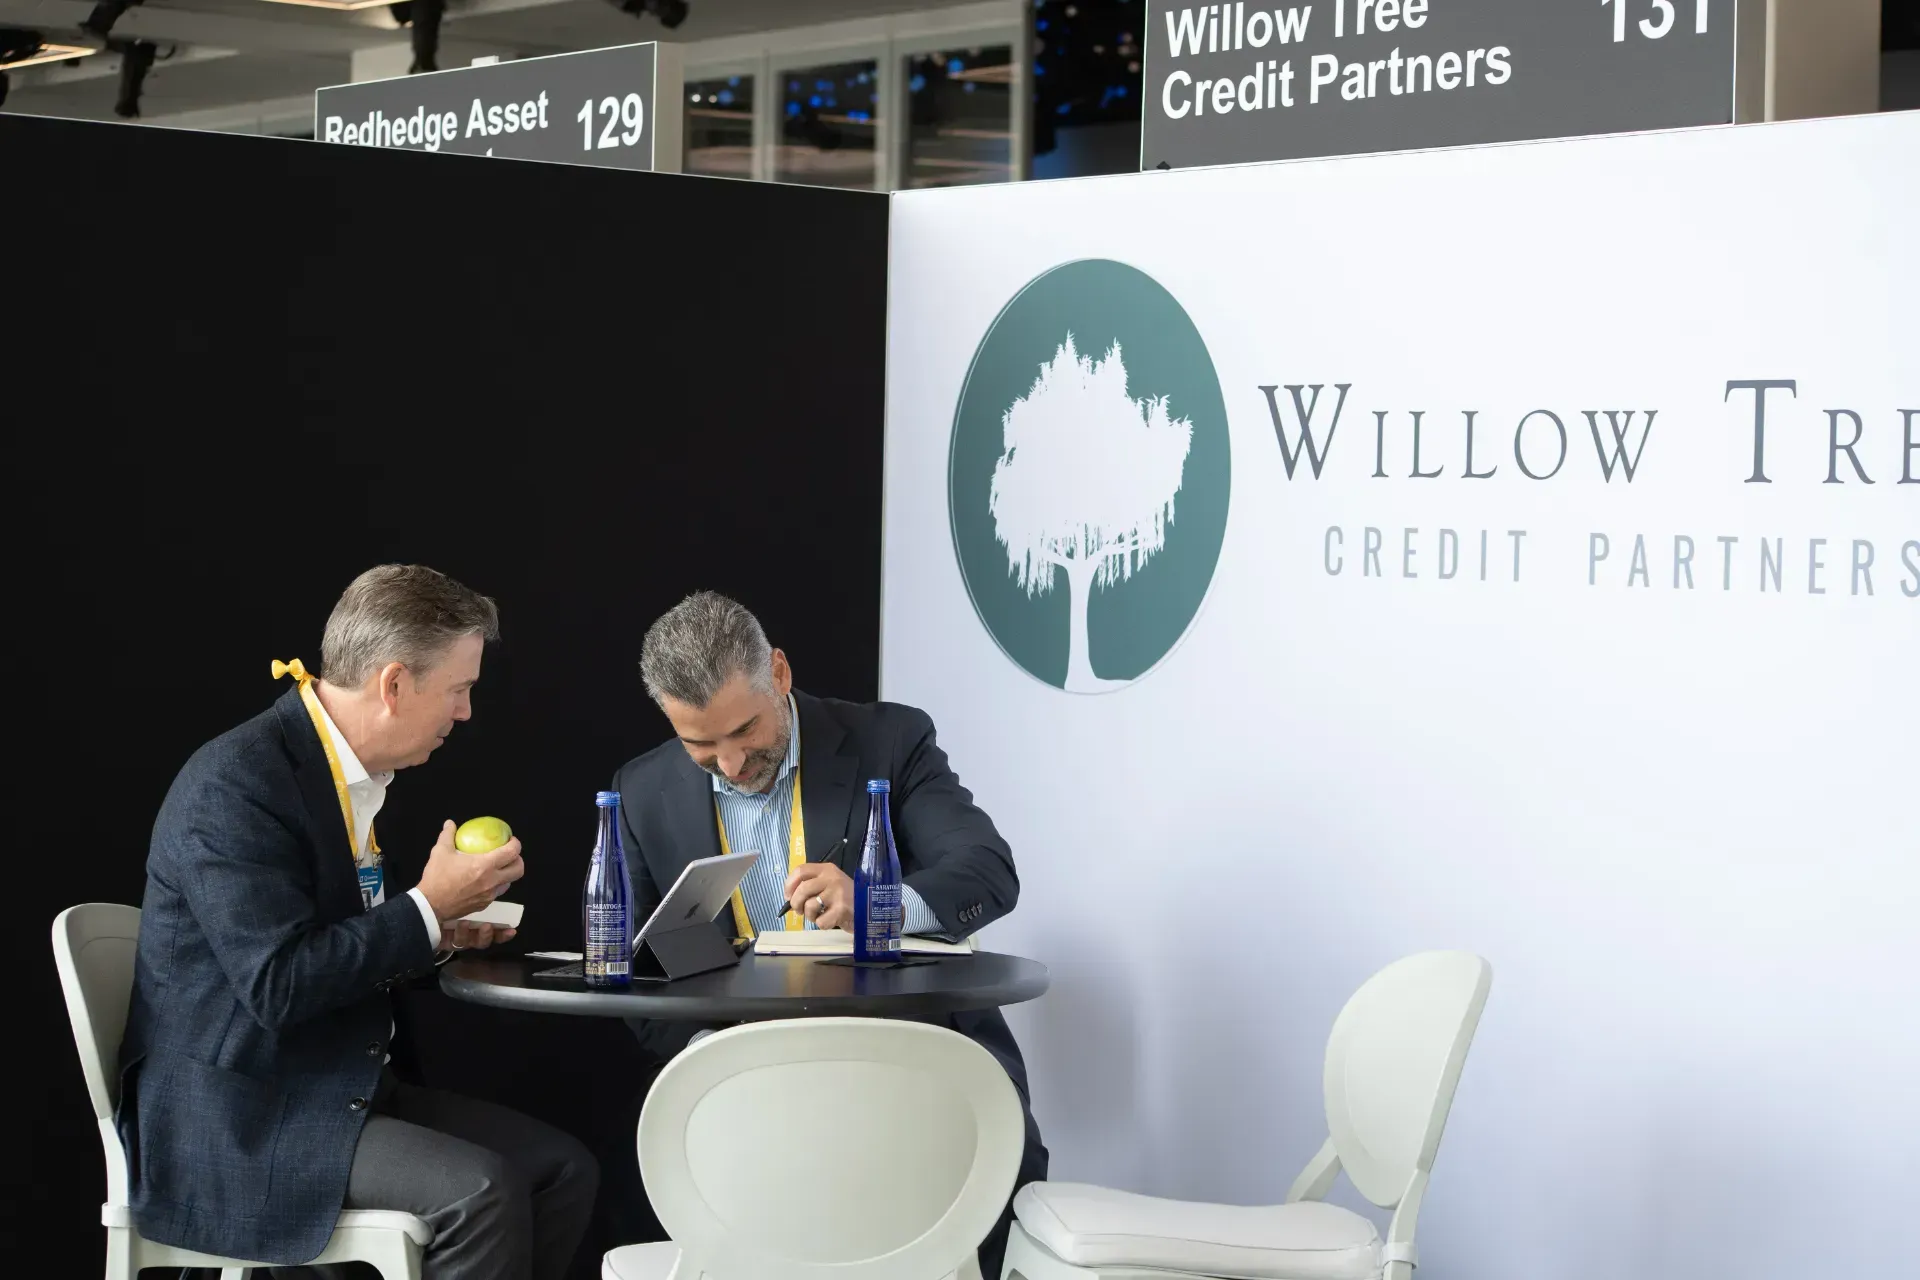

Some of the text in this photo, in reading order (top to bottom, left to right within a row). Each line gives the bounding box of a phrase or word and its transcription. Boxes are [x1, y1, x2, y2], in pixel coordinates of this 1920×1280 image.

[1165, 2, 1313, 58] Willow
[1162, 45, 1512, 120] Credit Partners
[325, 90, 549, 152] Redhedge Asset
[577, 92, 644, 151] 129
[1257, 383, 1660, 484] WILLOW
[1324, 525, 1920, 598] CREDIT PARTNERS
